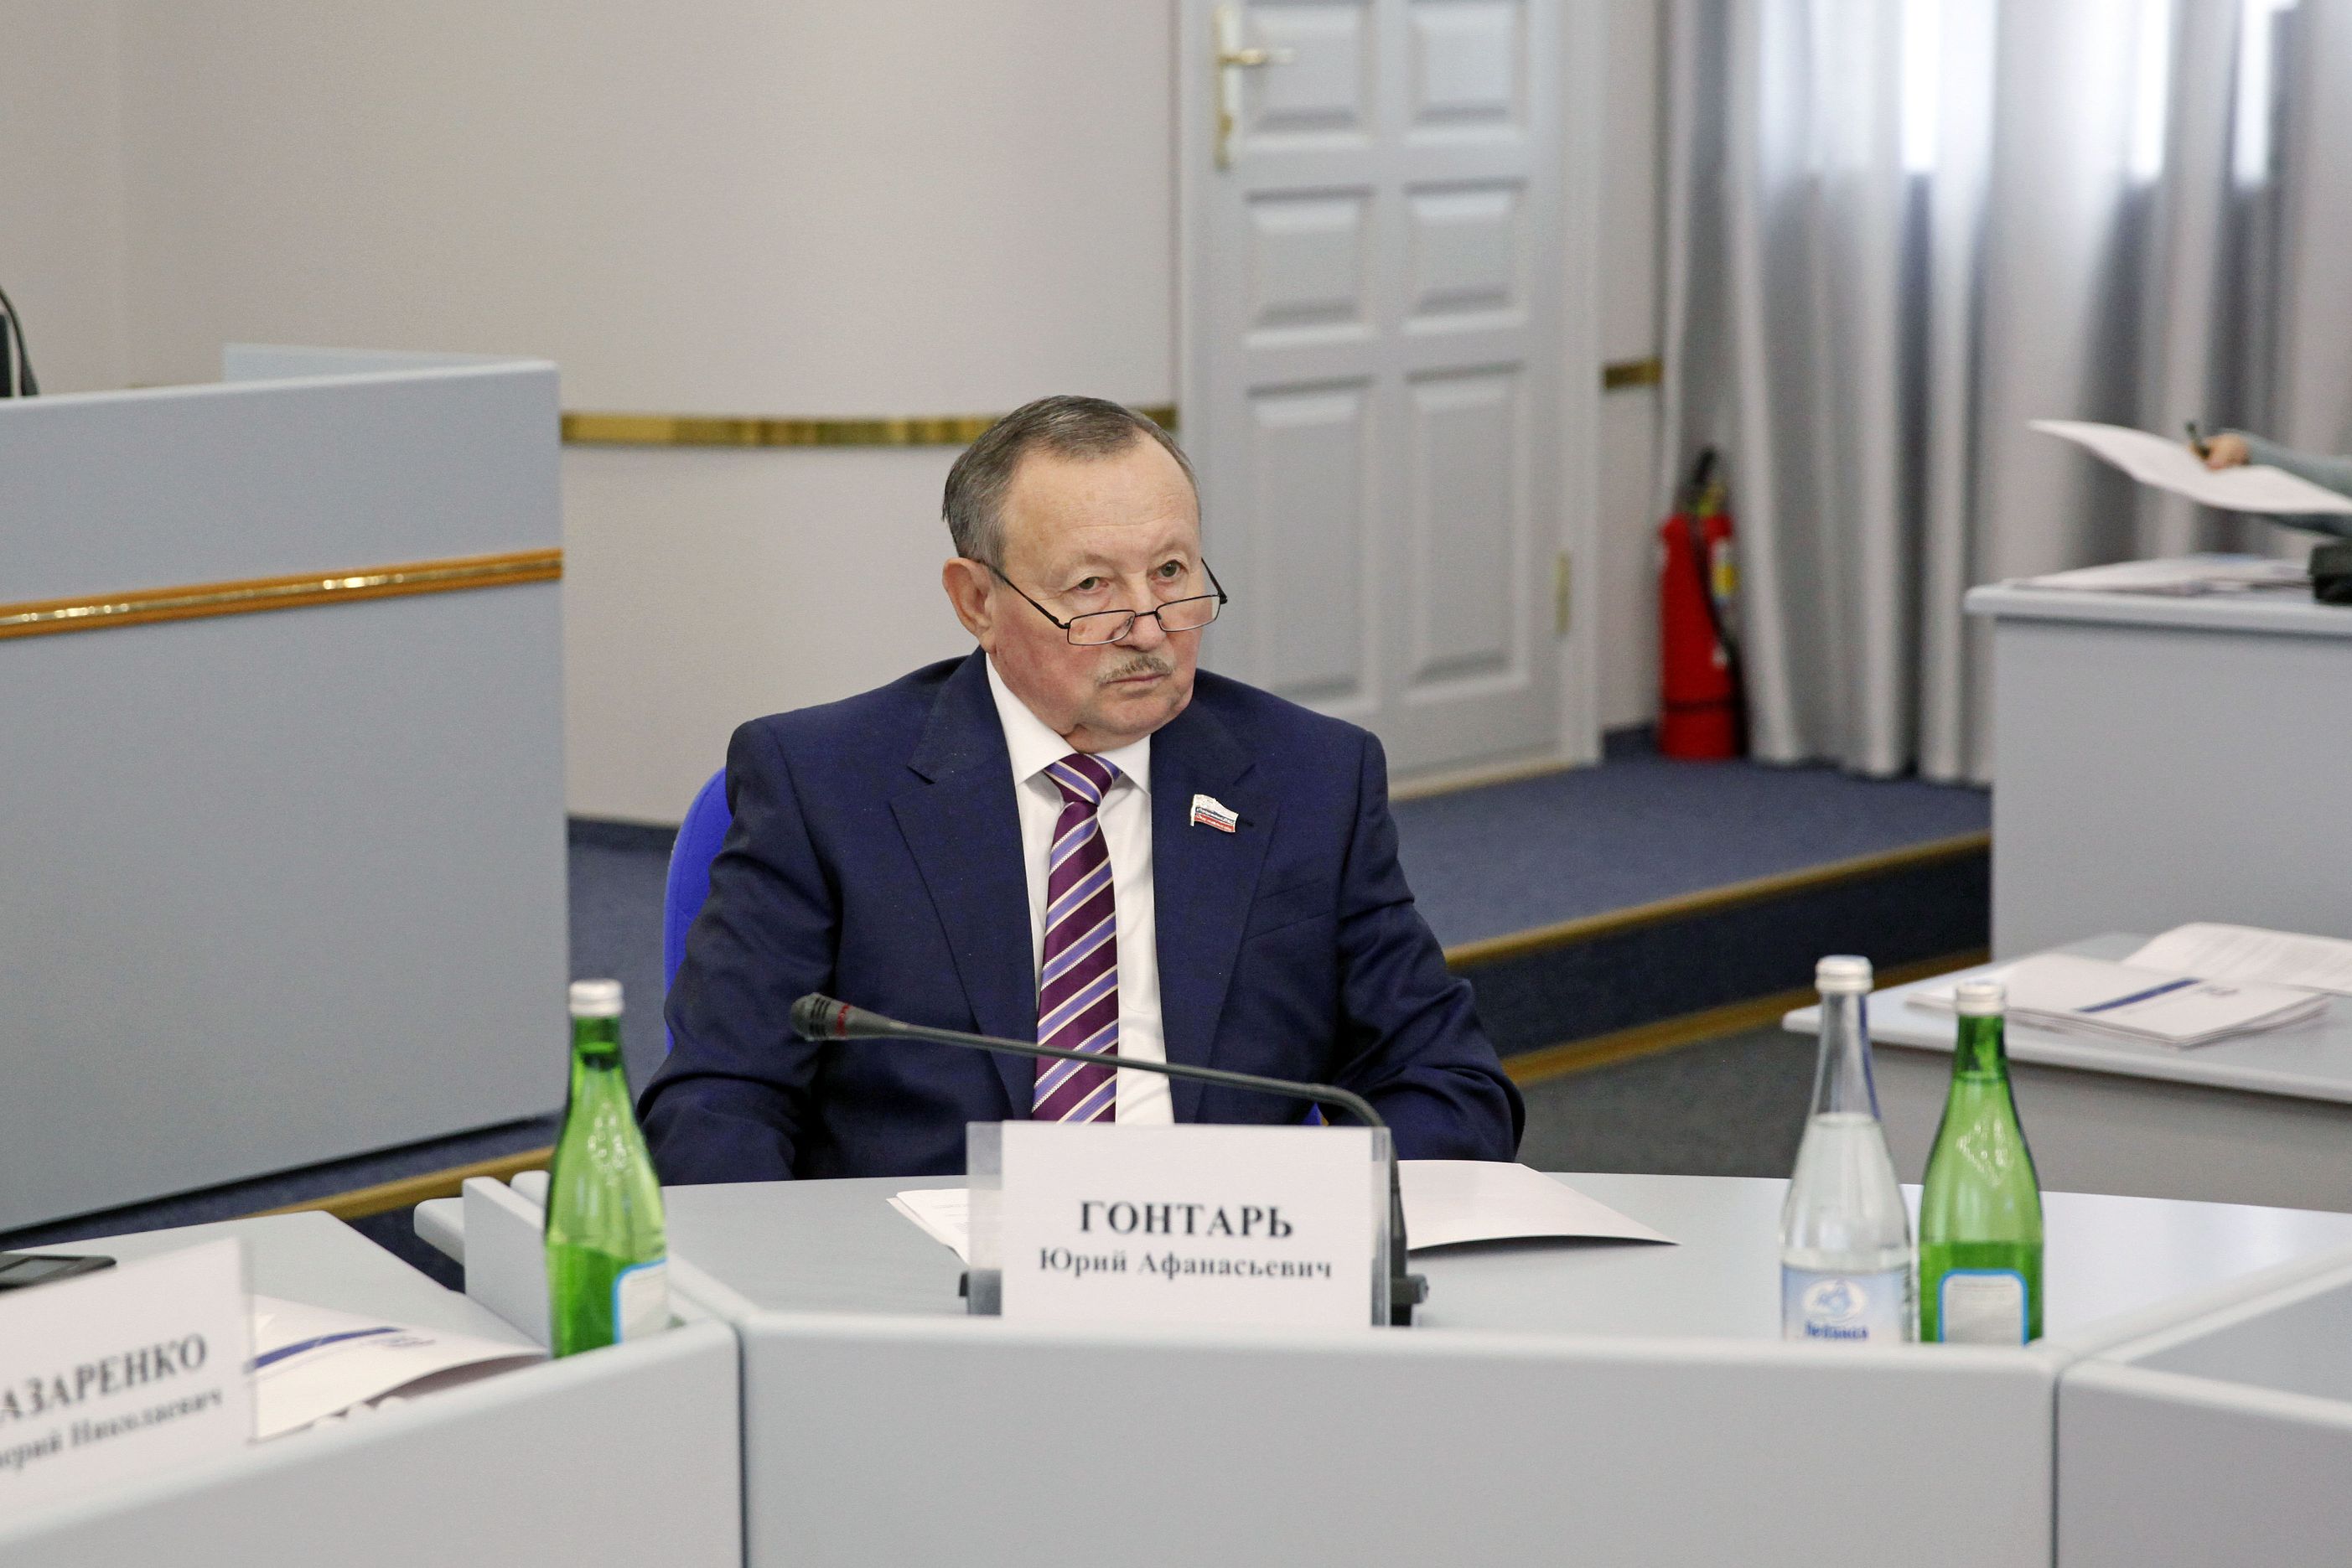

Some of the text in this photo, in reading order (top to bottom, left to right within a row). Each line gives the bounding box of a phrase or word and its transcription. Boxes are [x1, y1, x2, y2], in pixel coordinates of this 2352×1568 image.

[1080, 1200, 1294, 1238] ГОНТАРЬ
[1039, 1247, 1333, 1281] Юрий Афанасьевич
